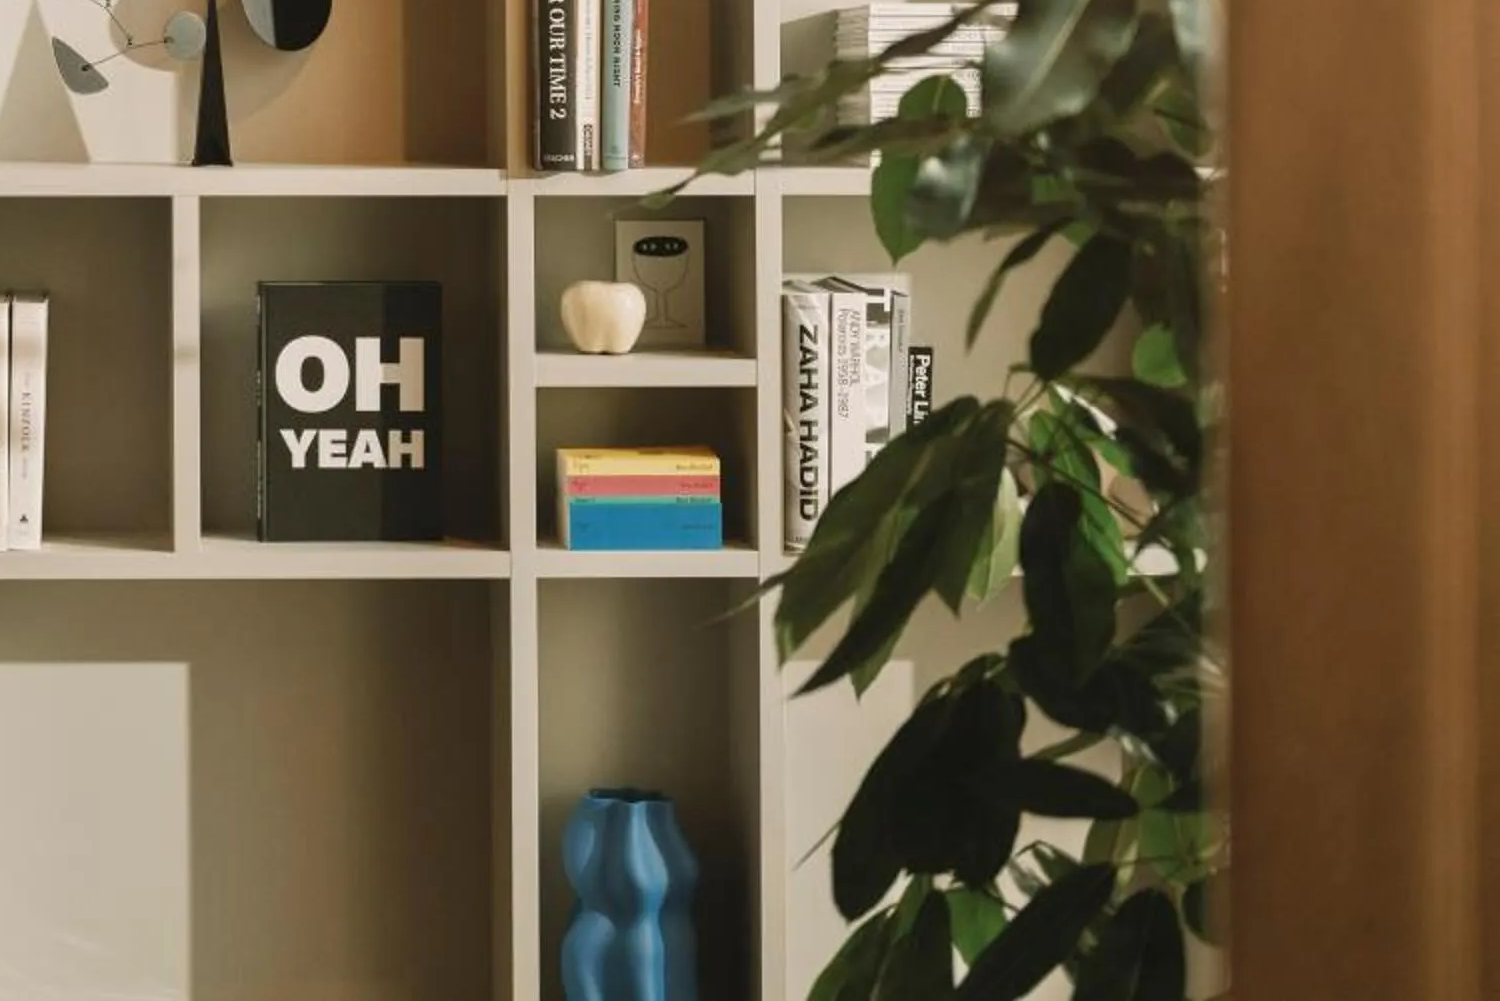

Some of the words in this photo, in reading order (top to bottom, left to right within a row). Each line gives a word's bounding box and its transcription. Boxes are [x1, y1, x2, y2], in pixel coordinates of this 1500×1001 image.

[549, 7, 566, 52] OUR
[549, 54, 567, 104] TIME
[550, 108, 567, 120] 2
[275, 334, 425, 414] OH
[799, 324, 819, 413] ZAHA
[914, 354, 931, 398] Peter
[20, 392, 32, 452] KINFOLK
[279, 429, 425, 468] YEAH
[799, 419, 819, 521] HADID
